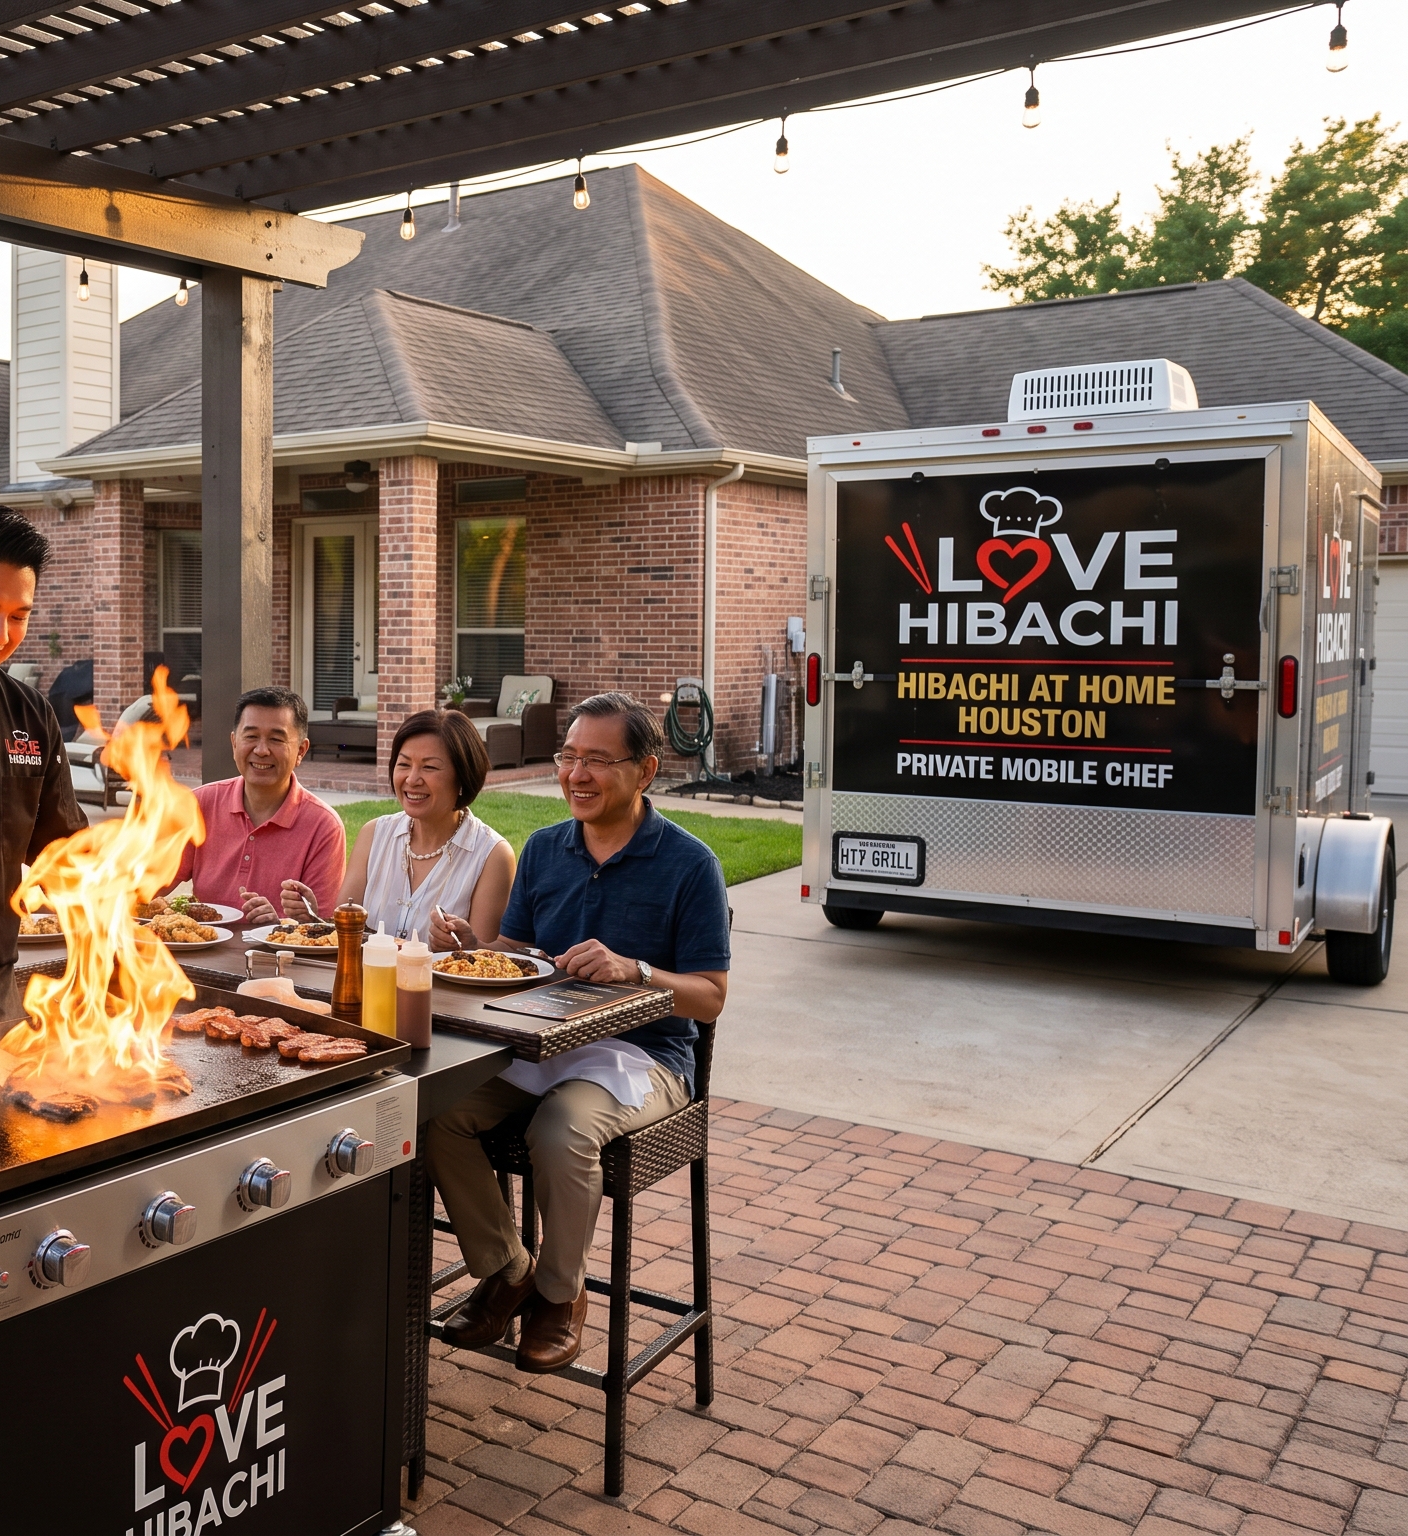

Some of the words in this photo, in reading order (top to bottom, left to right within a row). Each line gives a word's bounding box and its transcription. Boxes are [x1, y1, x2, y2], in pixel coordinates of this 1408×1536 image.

[937, 529, 1179, 603] LOVE
[897, 599, 1179, 647] HIBACHI
[896, 671, 1020, 702] HIBACHI
[1028, 673, 1069, 703] AT
[1078, 674, 1177, 706] HOME
[957, 705, 1107, 740] HOUSTON
[896, 752, 994, 781] PRIVATE
[1000, 757, 1098, 786] MOBILE
[1104, 761, 1174, 789] CHEF
[872, 850, 914, 870] GRILL
[134, 1374, 286, 1513] LOVE
[125, 1447, 286, 1536] IBACHI
